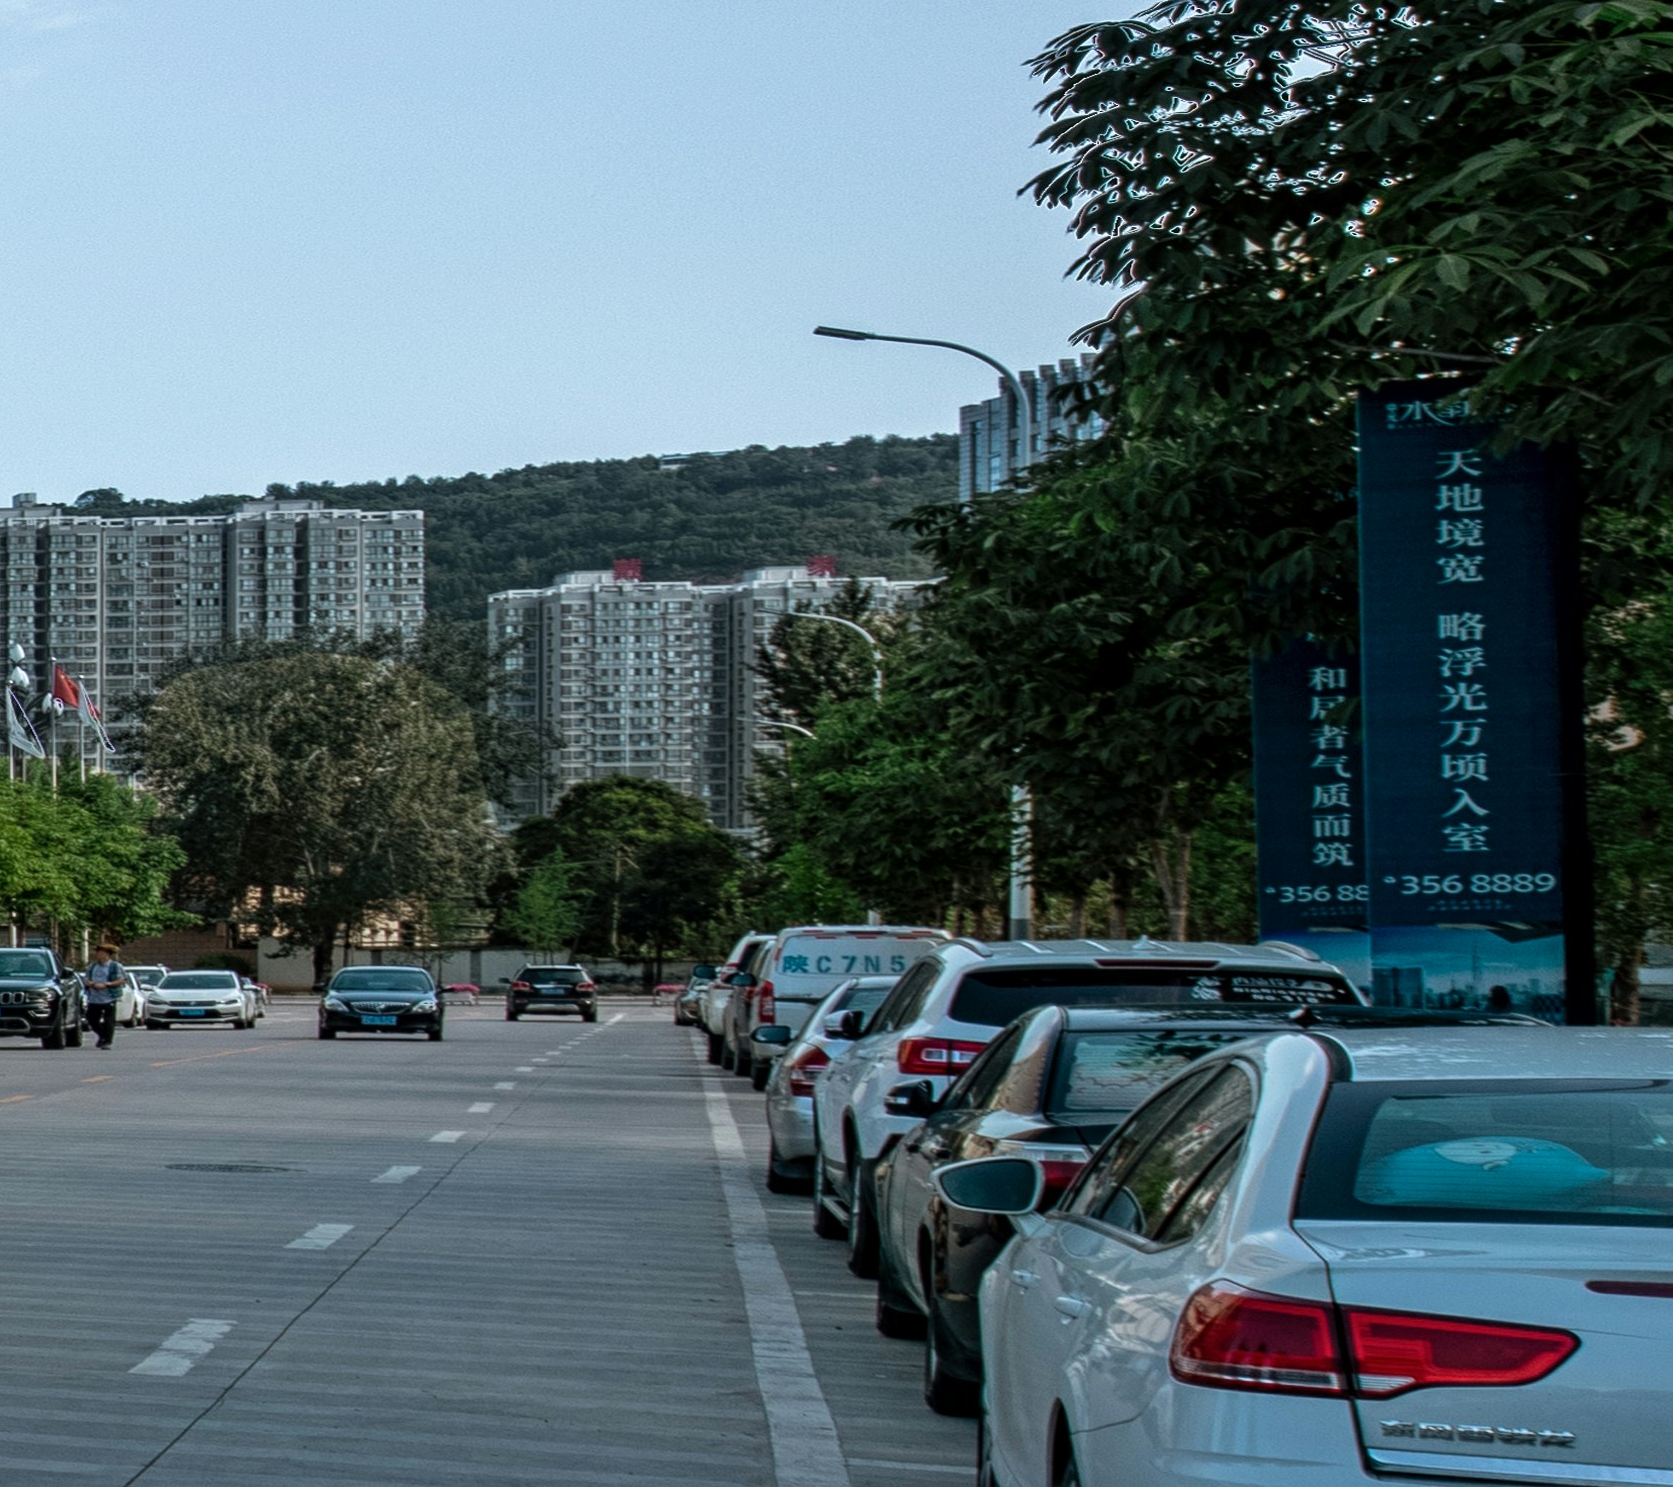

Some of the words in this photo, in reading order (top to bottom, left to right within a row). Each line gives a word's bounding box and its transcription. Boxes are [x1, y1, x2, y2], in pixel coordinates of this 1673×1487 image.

[1435, 449, 1485, 585] 天地境宽
[1437, 612, 1490, 853] 略浮光万顷入室
[1279, 886, 1331, 903] 356
[1400, 875, 1464, 895] 356
[1470, 873, 1557, 894] 8889
[783, 954, 914, 974] 陕C7N5
